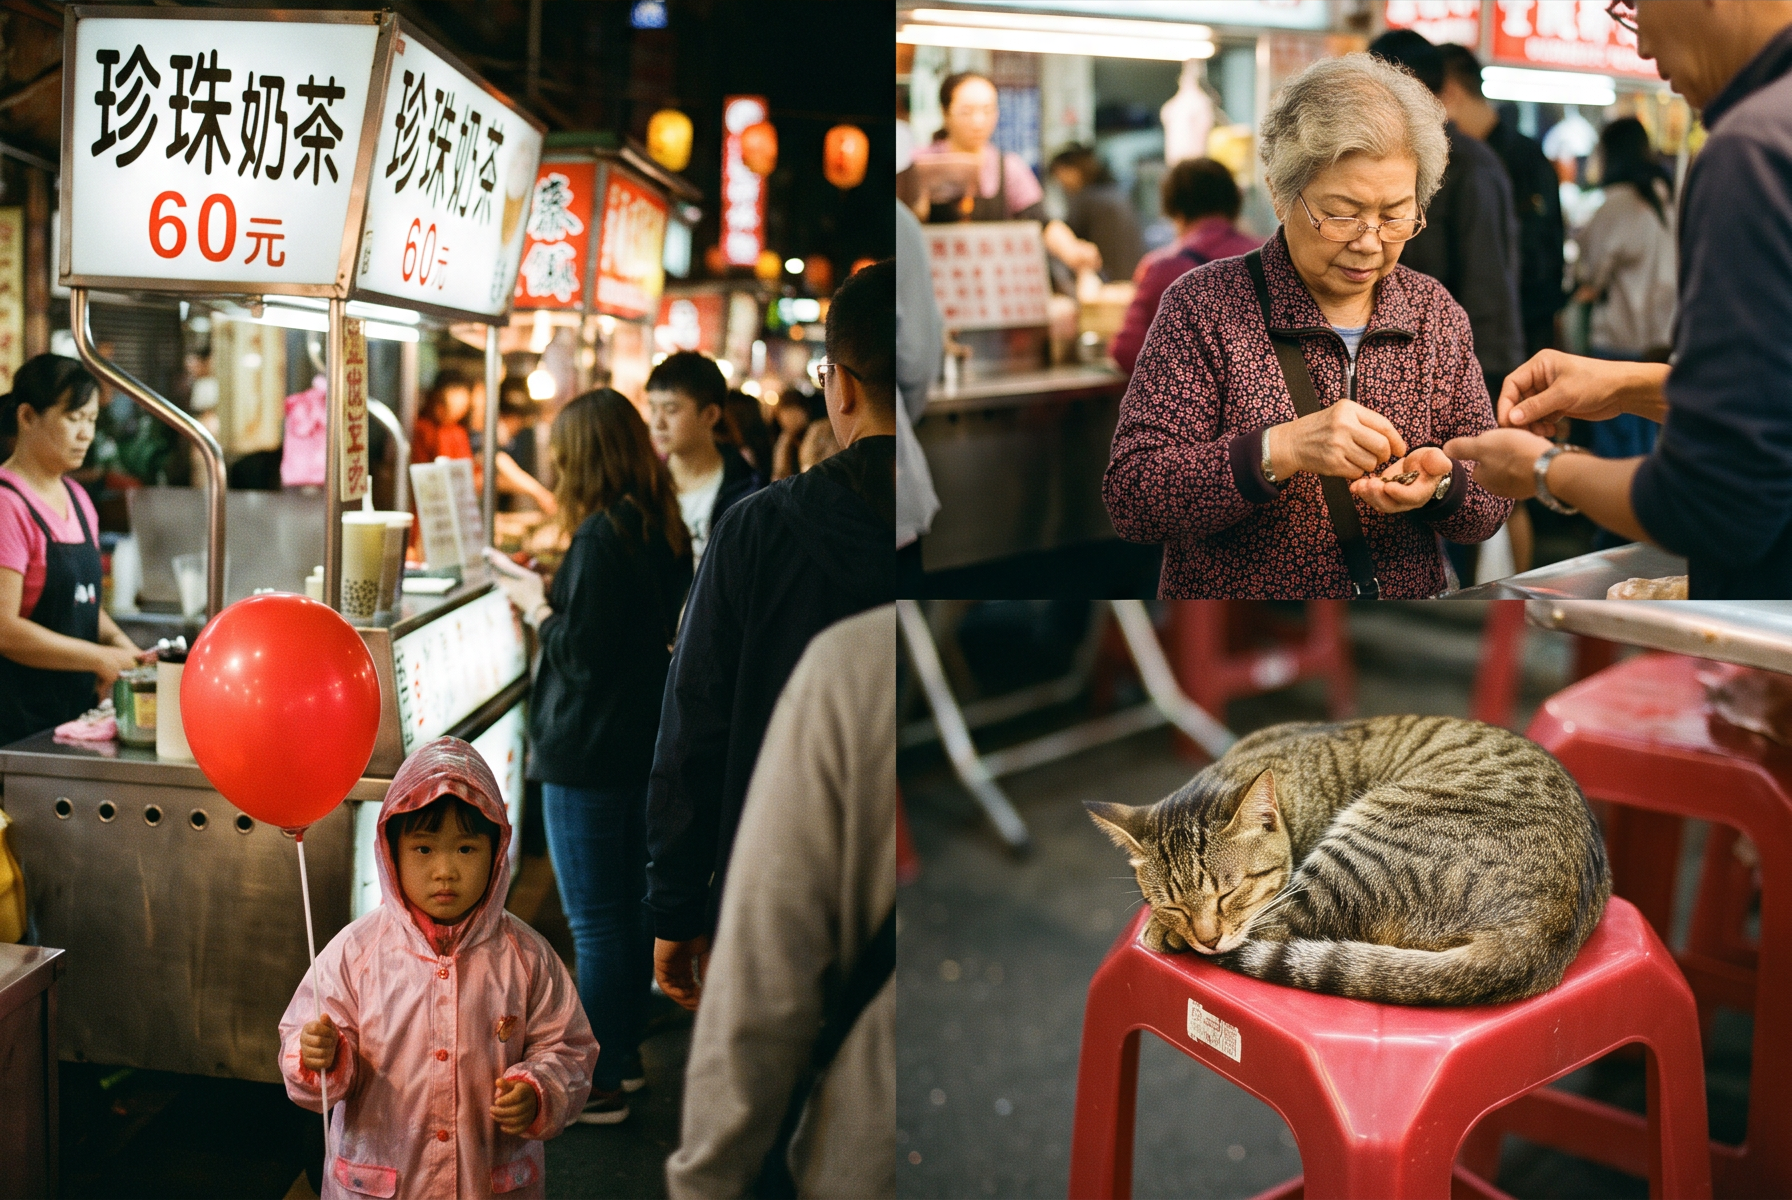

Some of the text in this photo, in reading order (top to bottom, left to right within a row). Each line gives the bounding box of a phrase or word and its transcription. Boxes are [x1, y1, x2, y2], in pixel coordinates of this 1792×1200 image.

[92, 44, 345, 186] 珍珠奶茶
[385, 69, 504, 226] 珍珠奶茶
[149, 191, 285, 267] 60元
[402, 217, 449, 290] 60元
